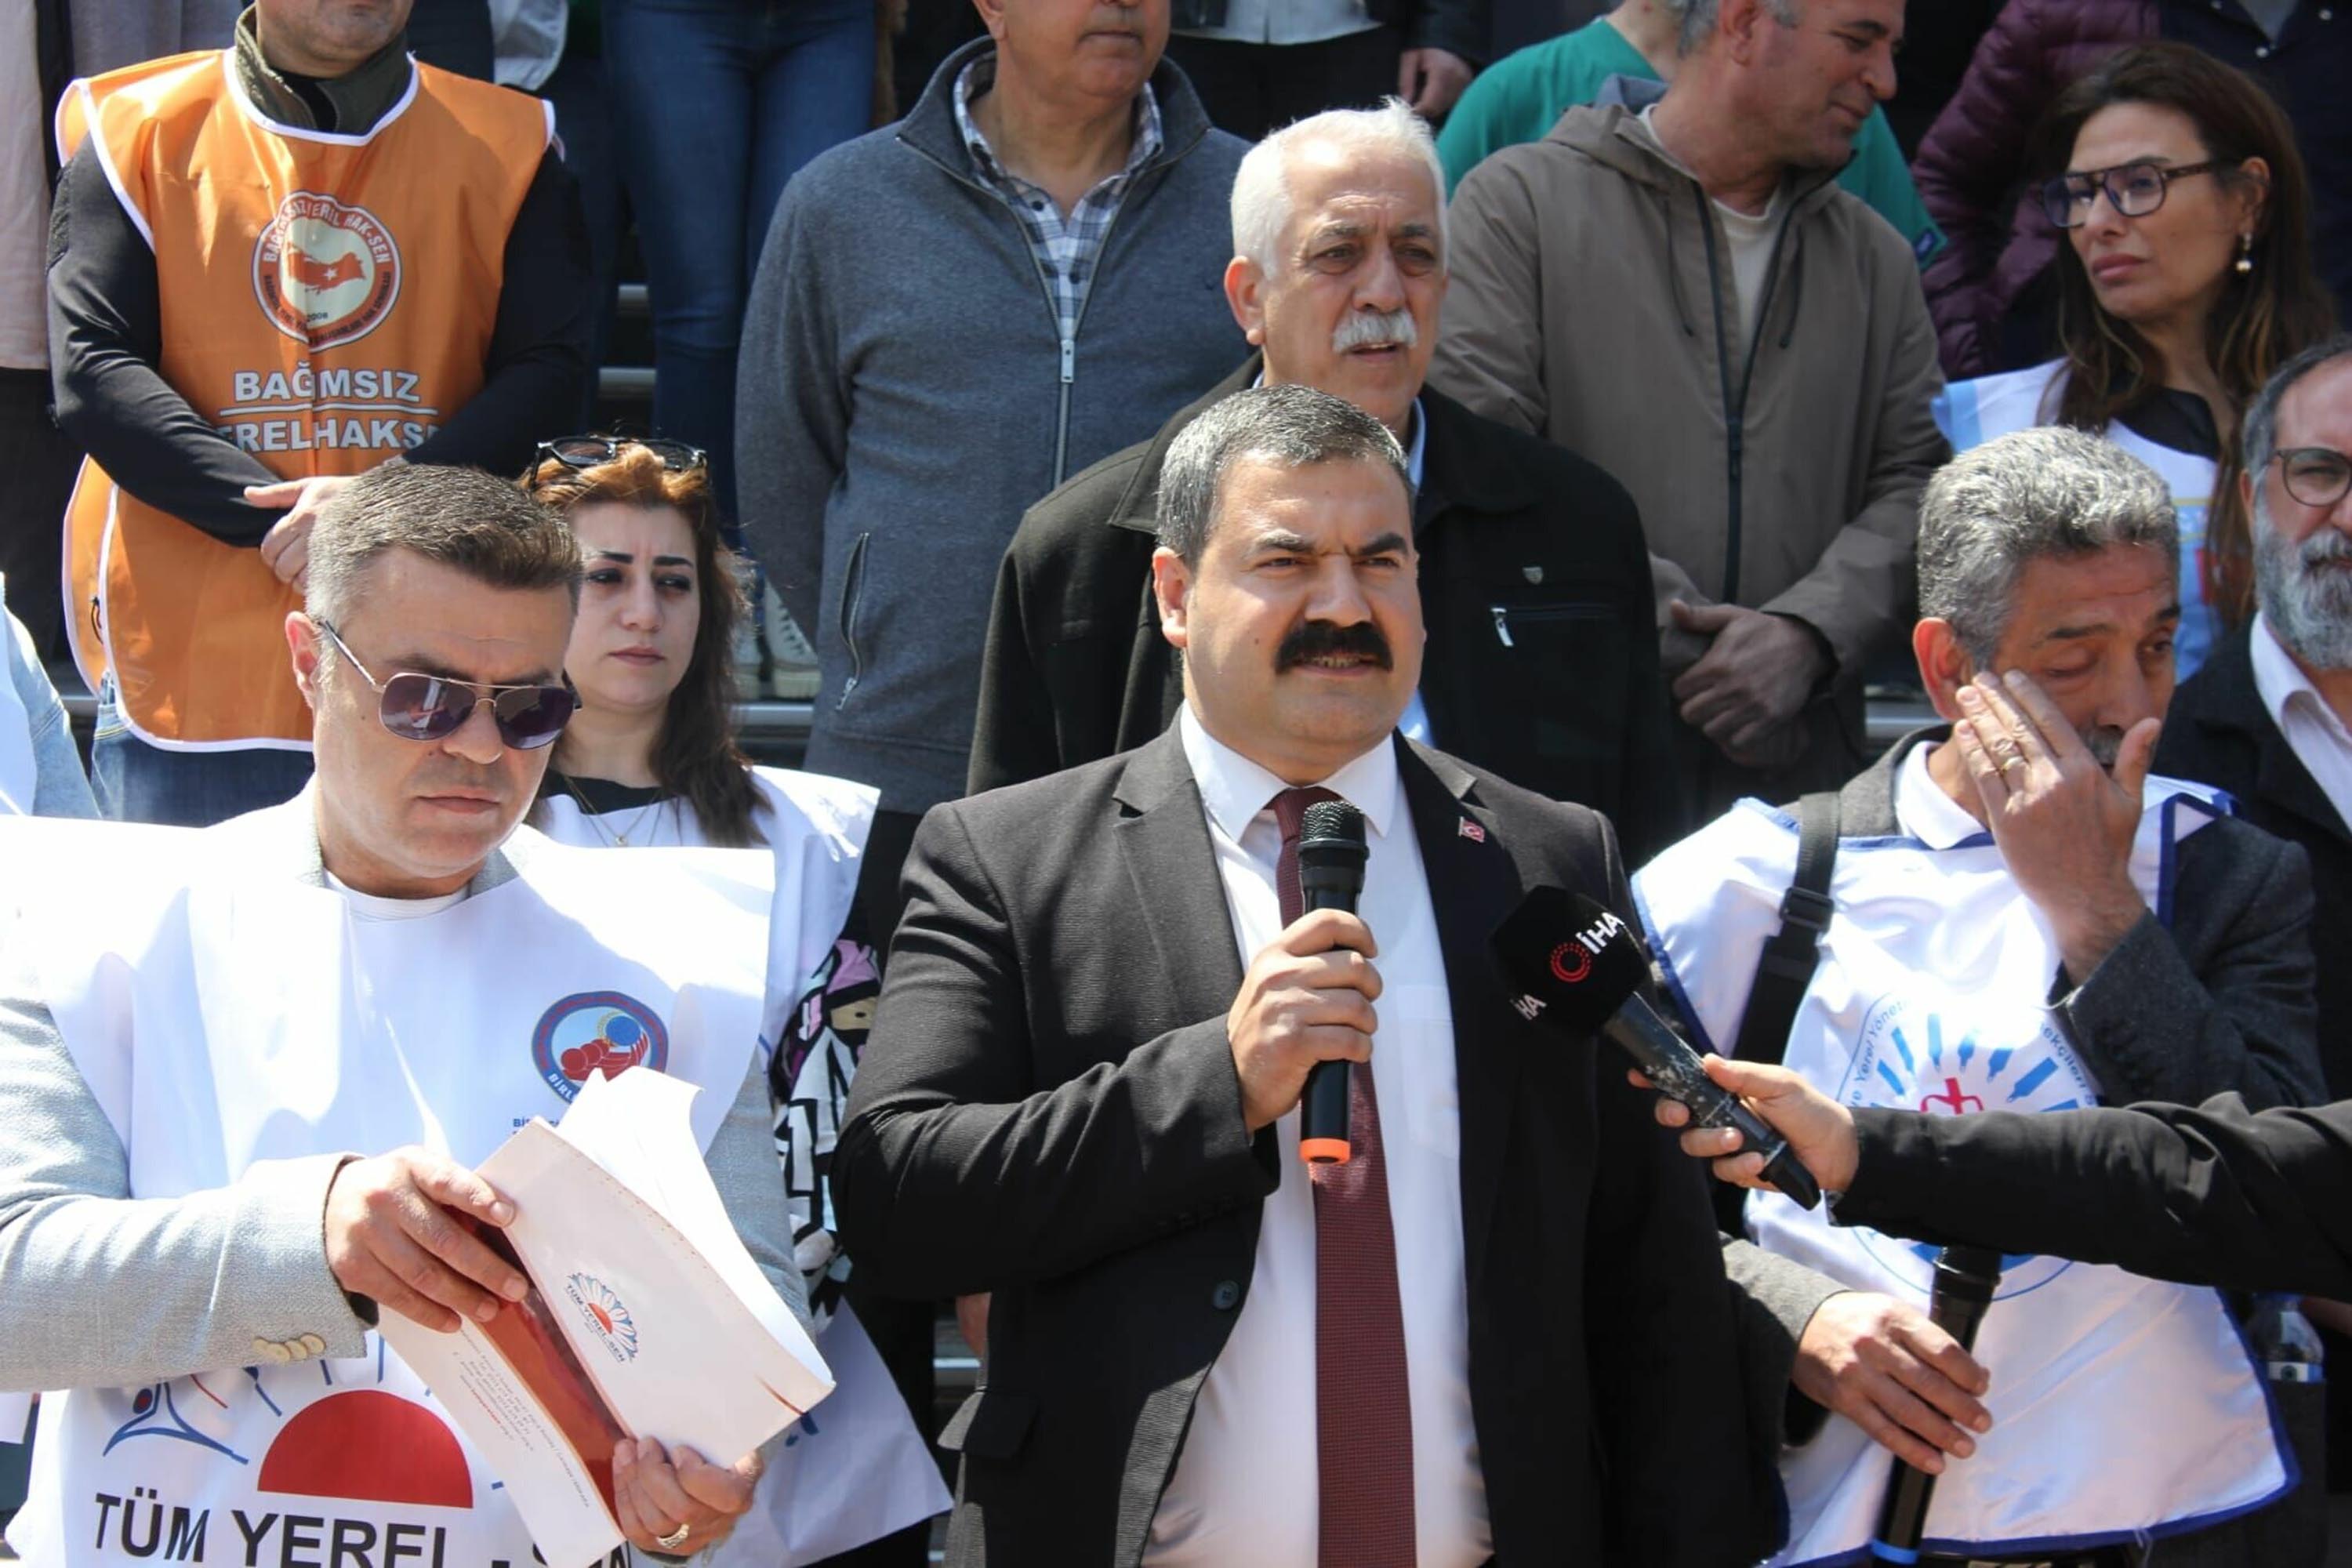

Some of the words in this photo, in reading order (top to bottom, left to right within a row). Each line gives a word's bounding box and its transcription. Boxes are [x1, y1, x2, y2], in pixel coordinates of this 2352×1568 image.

[234, 360, 420, 402] BAĞMSIZ
[1575, 912, 1625, 955] İHA
[96, 1486, 210, 1563] TÜM
